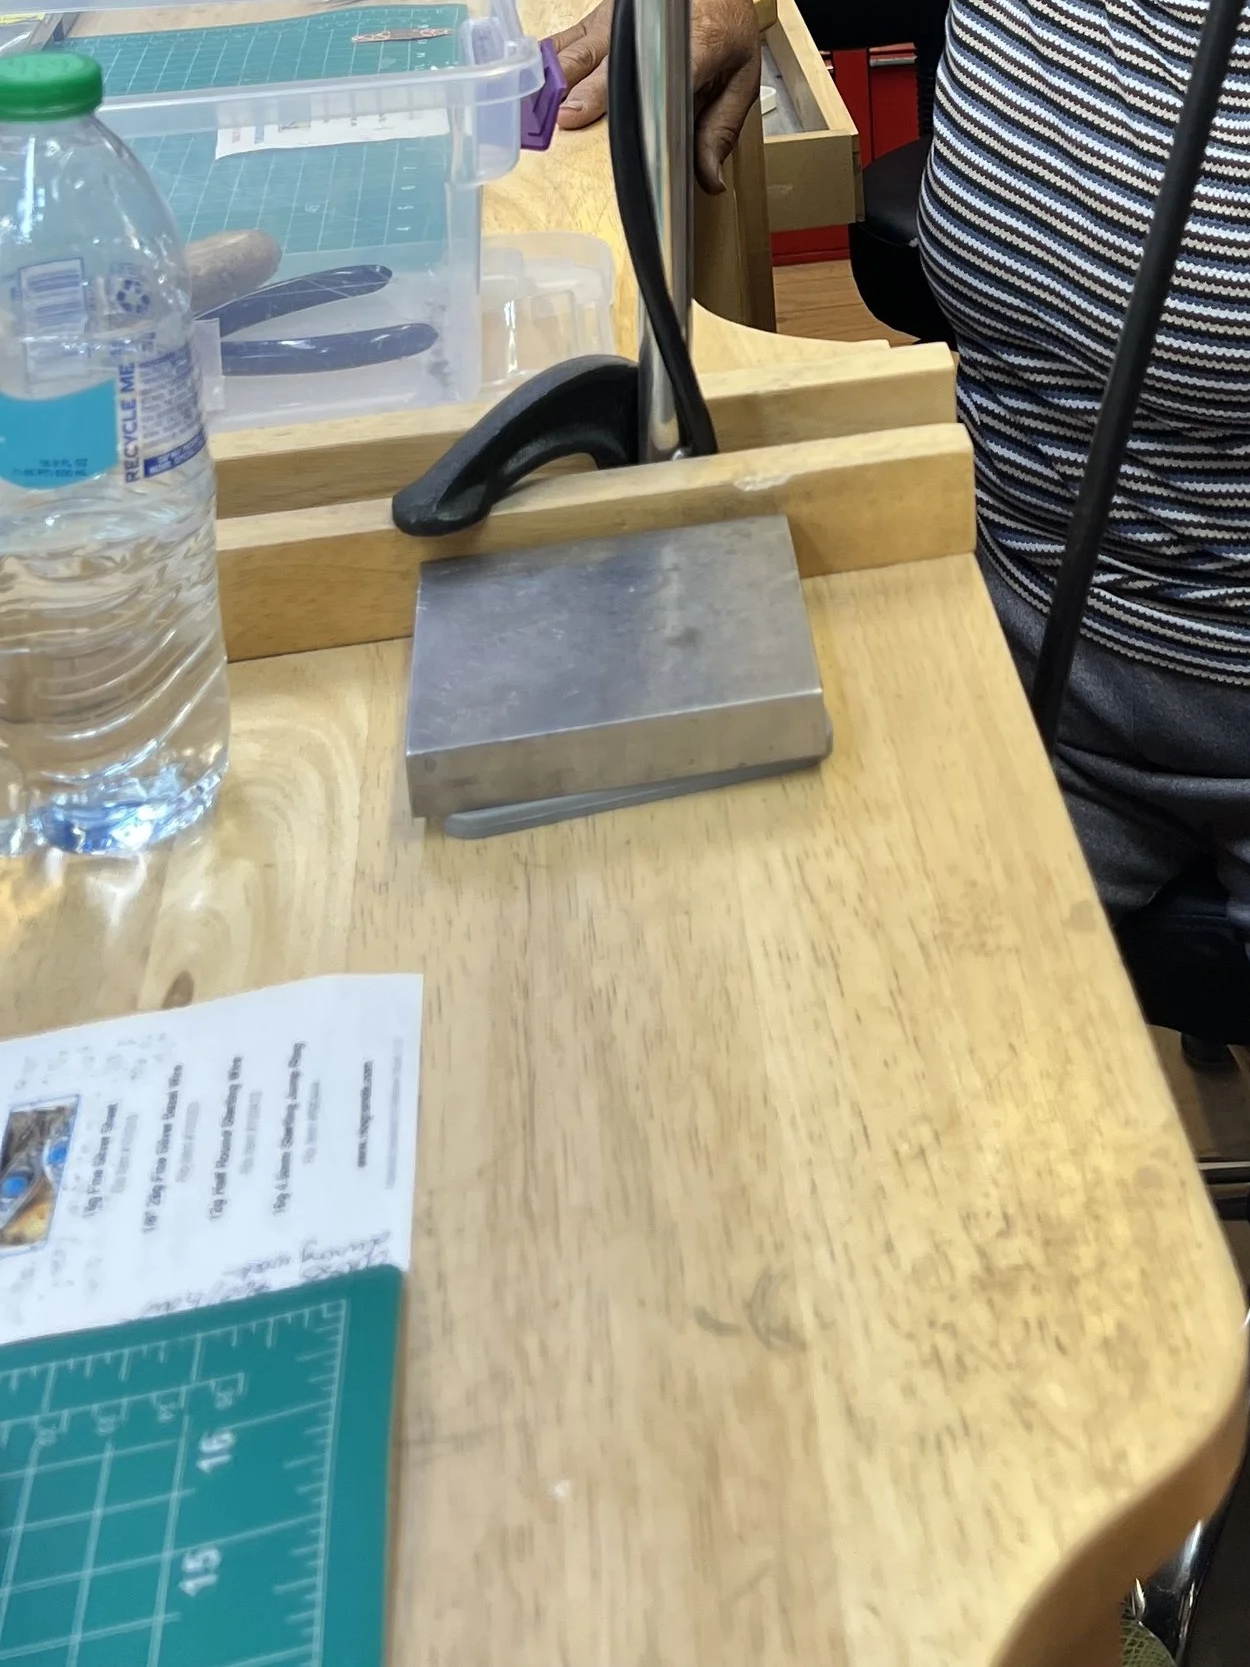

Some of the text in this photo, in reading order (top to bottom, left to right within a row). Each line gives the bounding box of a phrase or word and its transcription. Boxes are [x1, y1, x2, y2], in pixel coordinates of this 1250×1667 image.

[118, 362, 140, 483] RECYCLE ME
[195, 1427, 237, 1474] 16
[177, 1546, 223, 1597] 15
